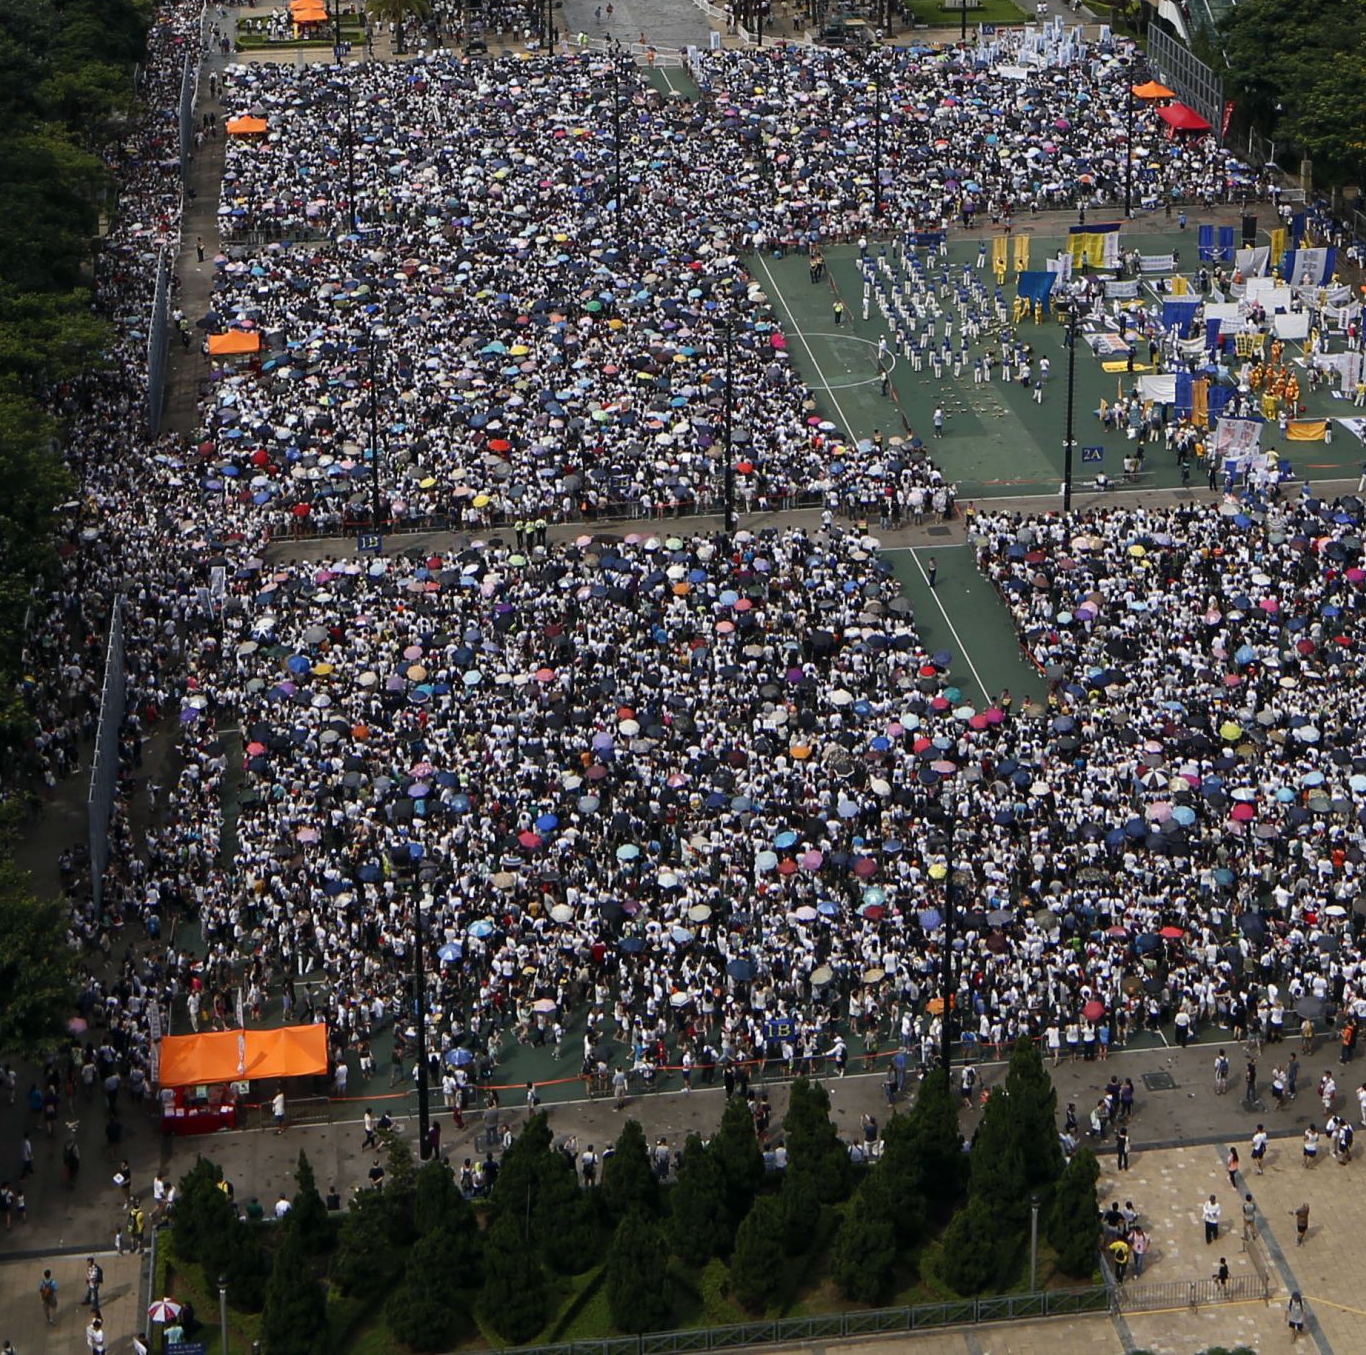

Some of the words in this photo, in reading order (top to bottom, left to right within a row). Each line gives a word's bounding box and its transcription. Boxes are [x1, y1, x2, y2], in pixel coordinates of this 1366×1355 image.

[1083, 449, 1101, 460] 2A
[361, 536, 379, 548] 1B
[766, 1024, 790, 1037] 1B
